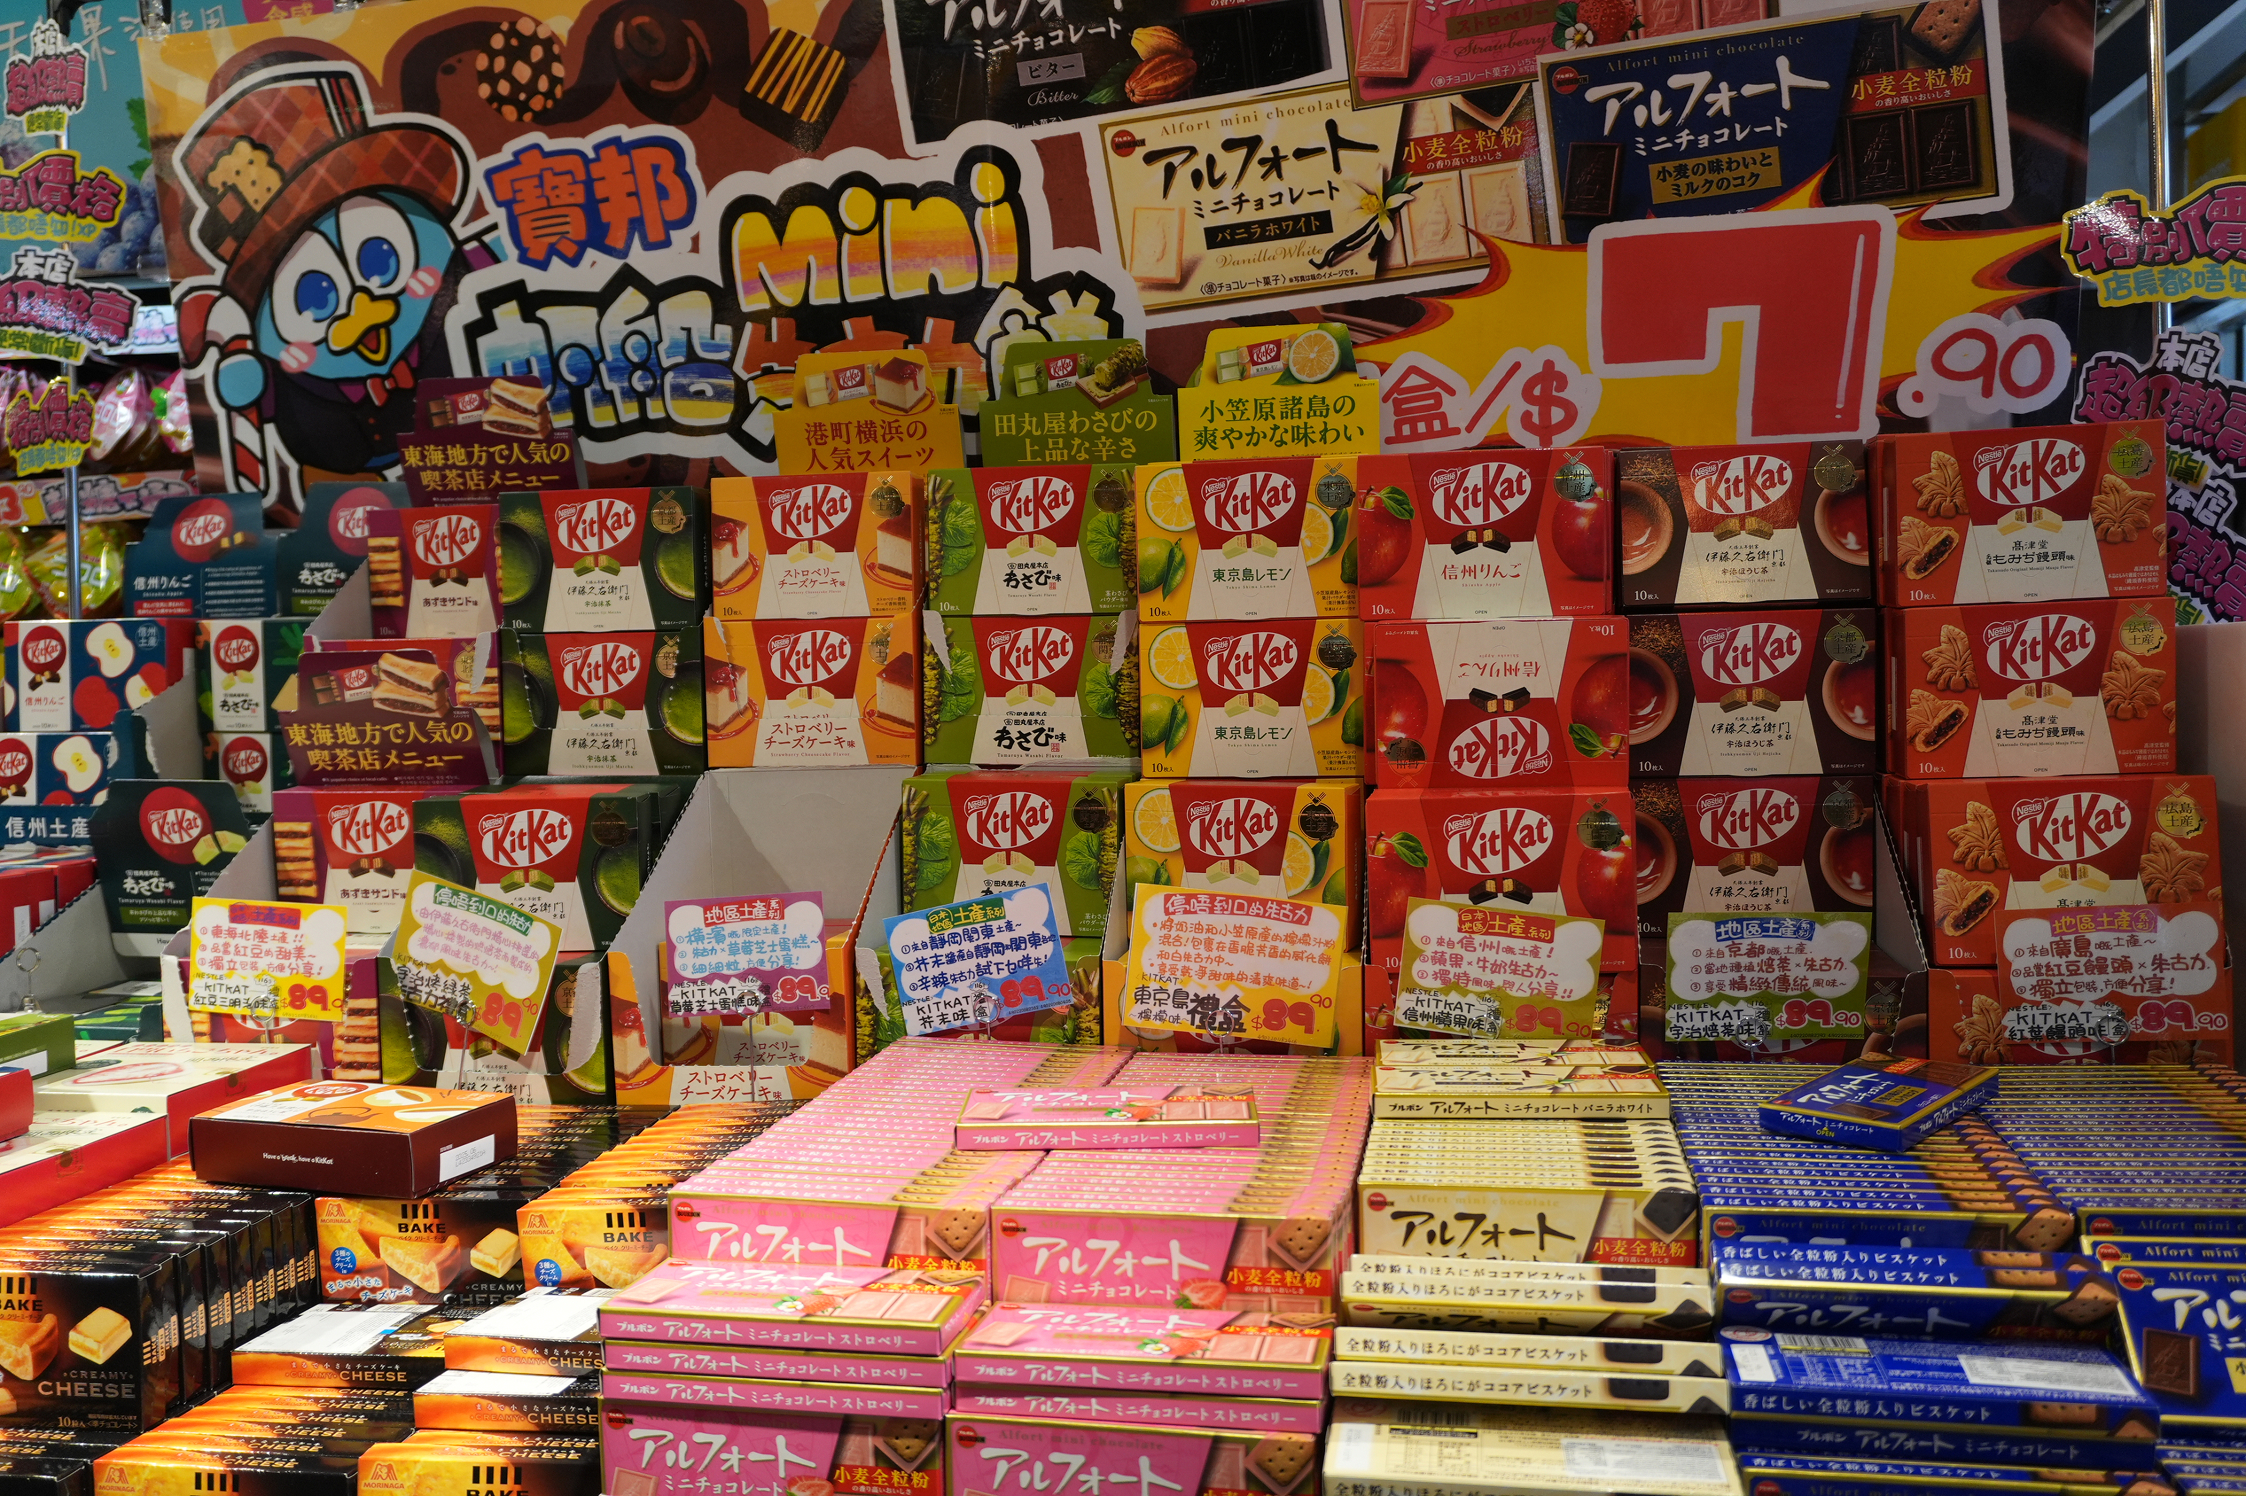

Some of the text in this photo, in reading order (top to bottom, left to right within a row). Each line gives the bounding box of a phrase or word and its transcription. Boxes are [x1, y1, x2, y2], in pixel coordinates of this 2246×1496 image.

[1456, 7, 1549, 34] ストロベリー
[973, 17, 1121, 59] ミニチョコレート
[1454, 30, 1548, 57] Strawberry
[1605, 33, 1805, 73] Alfort mini chocolate
[1027, 61, 1075, 79] ビター
[1850, 63, 1973, 101] 小麦全粒粉
[1027, 88, 1079, 107] Bitter
[1585, 56, 1830, 136] アルフォート
[1161, 99, 1351, 136] Alfort mini chocolate
[1402, 126, 1523, 163] 小麦全粒粉
[1634, 117, 1788, 158] ミニチョコレート
[1142, 119, 1379, 199] アルフォート
[1426, 151, 1502, 169] の香り高いおいしさ
[1656, 153, 1773, 183] 小麦の味わいと
[1670, 174, 1761, 199] ミルクのコク
[490, 142, 688, 264] 寶邦
[1193, 182, 1340, 218] ミニチョコレート
[1215, 216, 1321, 242] バニラホワイト
[17, 251, 72, 282] 本店
[1216, 248, 1276, 269] Vanilla
[2158, 335, 2216, 378] 本店
[994, 407, 1158, 437] 田丸屋わさびの
[1199, 395, 1357, 424] 小笠原諸島の
[804, 419, 929, 447] 港町横浜の
[1192, 421, 1366, 453] 爽やかな味わい
[403, 442, 570, 467] 東海地方で人気の
[805, 446, 935, 473] 人気スイーツ
[1016, 436, 1139, 464] 上品な辛さ
[421, 469, 560, 491] 喫茶店メニュー
[1706, 456, 1790, 514] KitKat
[999, 478, 1071, 531] KitKat
[1214, 472, 1292, 531] KitKat
[1444, 463, 1529, 525] KitKat
[781, 484, 849, 538] KitKat
[181, 514, 226, 545] KitKat
[564, 499, 632, 553] KitKat
[421, 515, 477, 565] KitKat
[133, 575, 192, 590] 信州りんご
[777, 578, 846, 590] チーズケーキ味
[783, 568, 840, 580] ストロベリー
[1212, 567, 1292, 583] 東京島レモン
[1441, 563, 1522, 581] 信州りんご
[722, 606, 743, 616] 10枚入
[1149, 607, 1172, 617] 10枚入
[1371, 603, 1396, 615] 10枚入
[780, 630, 848, 684] KitKat
[999, 628, 1070, 680] KitKat
[1217, 633, 1294, 690] KitKat
[1713, 624, 1797, 684] KitKat
[570, 644, 637, 696] KitKat
[1458, 661, 1542, 679] 信州りんご
[286, 723, 473, 745] 東海地方で人気の
[771, 722, 848, 735] ストロベリー
[1214, 726, 1293, 740] 東京島レモン
[763, 736, 856, 750] チーズケーキ味
[308, 749, 464, 772] 喫茶店メニュー
[5, 816, 90, 839] 信州土産
[155, 809, 202, 844] KitKat
[341, 801, 409, 853] KitKat
[976, 793, 1050, 848] KitKat
[1200, 799, 1277, 856] KitKat
[1711, 790, 1797, 849] KitKat
[489, 808, 570, 867] KitKat
[1460, 810, 1551, 874] KitKat
[705, 902, 767, 924] 地區土產
[1165, 893, 1310, 925] 停唔到口的朱古力
[2052, 909, 2133, 934] 地區土產
[1716, 918, 1798, 941] 地區土產
[1948, 947, 1977, 960] 10枚入
[204, 983, 249, 995] KITKAT
[681, 985, 736, 999] KITKAT
[1134, 984, 1190, 1009] 東京島
[916, 995, 970, 1015] KITKAT
[1415, 997, 1475, 1014] KITKAT
[1676, 1009, 1744, 1023] KITKAT
[1774, 998, 1861, 1028] $89.90
[2130, 1000, 2228, 1033] $89.90
[919, 1009, 970, 1029] 芥末味
[1505, 1003, 1592, 1038] $89.90
[2016, 1011, 2092, 1026] KITKAT
[688, 1070, 773, 1083] ストロベリー
[680, 1087, 783, 1102] チーズケーキ味
[1388, 1101, 1653, 1115] ブルボン アルフォート ミニチョコレート バニラホワイト
[1815, 1129, 1836, 1137] OPEN
[397, 1222, 447, 1233] BAKE
[603, 1231, 655, 1243] BAKE
[1391, 1210, 1576, 1251] アルフォート
[695, 1220, 872, 1266] アルフォート
[1592, 1239, 1688, 1257] 小麦全粒粉
[1722, 1244, 1949, 1268] 香ばしい全粒粉入りビスケット
[1022, 1236, 1211, 1282] アルフォート
[326, 1275, 383, 1294] まるで小さな
[470, 1282, 523, 1291] CREAMY
[1057, 1280, 1177, 1300] ミニチョコレート
[1226, 1269, 1323, 1289] 小麦全粒粉
[1351, 1280, 1586, 1302] 全粒粉入りほろにがココアビスケット
[1755, 1301, 1971, 1334] アルフォート
[617, 1321, 918, 1347] ブルボン アルフォート ミニチョコレート ストロベリー
[1345, 1338, 1589, 1363] 全粒粉入りほろにがココアビスケット
[69, 1370, 129, 1380] CREAMY
[340, 1371, 407, 1382] CHEESE
[622, 1352, 924, 1380] ブルボン アルフォート ミニチョコレート ストロベリー
[974, 1364, 1299, 1390] ブルボン アルフォート ミニチョコレート ストロベリー
[37, 1381, 136, 1398] CHEESE
[1340, 1373, 1593, 1398] 全粒粉入りほろにがココアビスケット
[525, 1414, 599, 1425] CHEESE
[1743, 1393, 1992, 1421] 香ばしい全粒粉入りビスケット
[628, 1428, 817, 1478] アルフォート
[1855, 1429, 2081, 1459] アルフォート ミニチョコレート
[834, 1466, 930, 1489] 小麦全粒粉
[979, 1446, 1184, 1496] アルフォート
